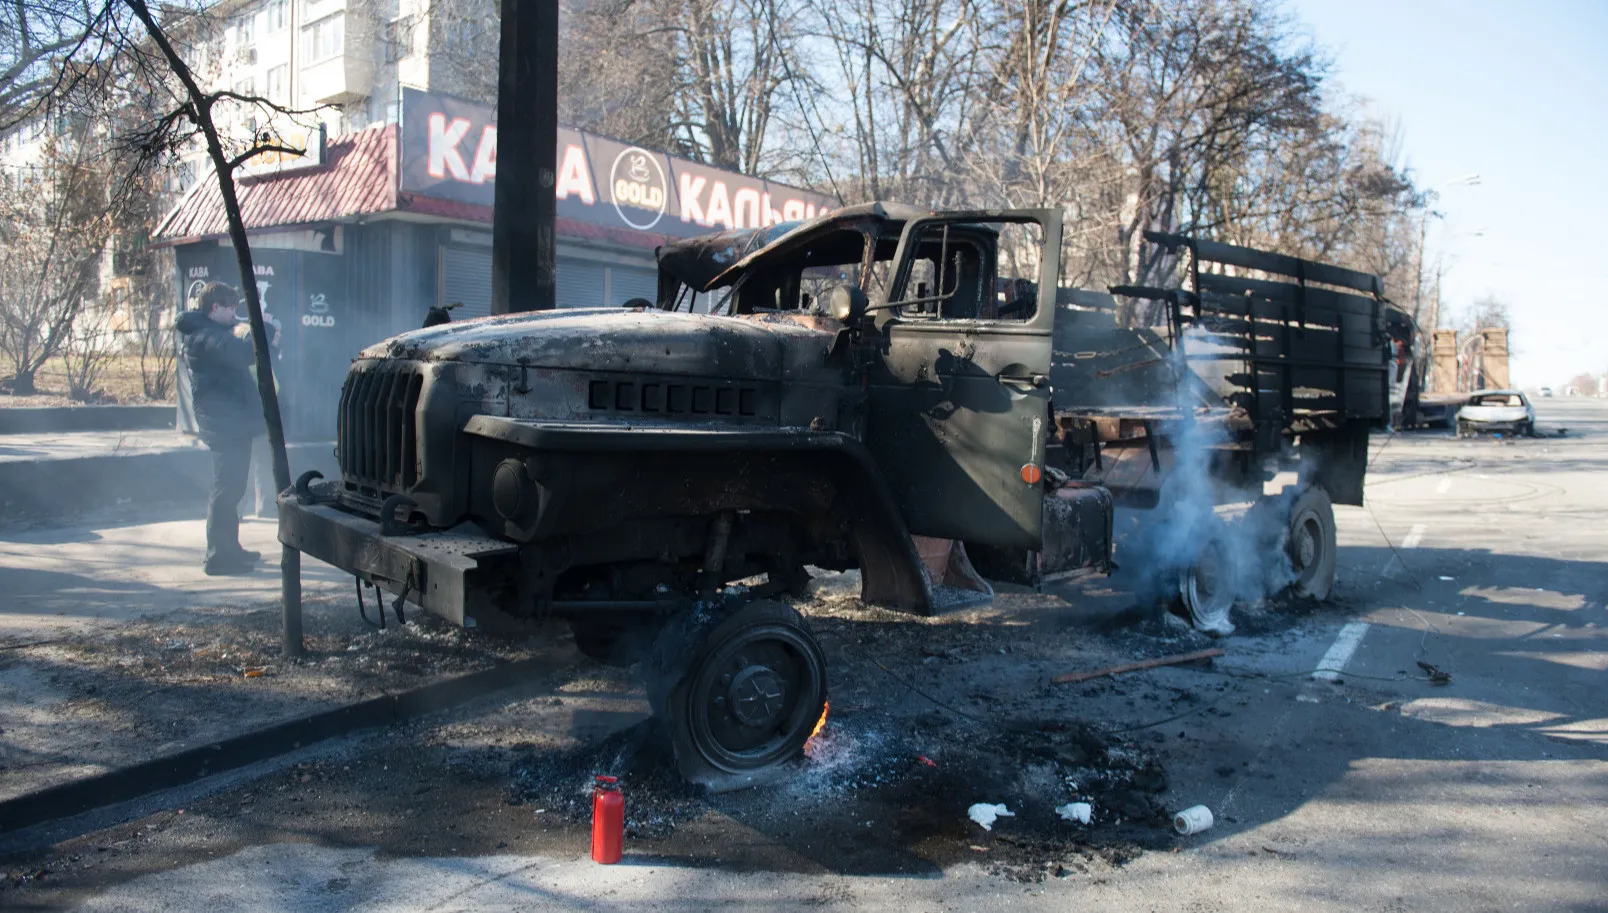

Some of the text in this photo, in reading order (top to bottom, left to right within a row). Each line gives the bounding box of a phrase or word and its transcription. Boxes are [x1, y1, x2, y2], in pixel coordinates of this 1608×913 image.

[427, 112, 596, 205] КАА
[615, 179, 663, 208] GOLD
[252, 265, 275, 276] АВА
[302, 314, 335, 327] GOLD
